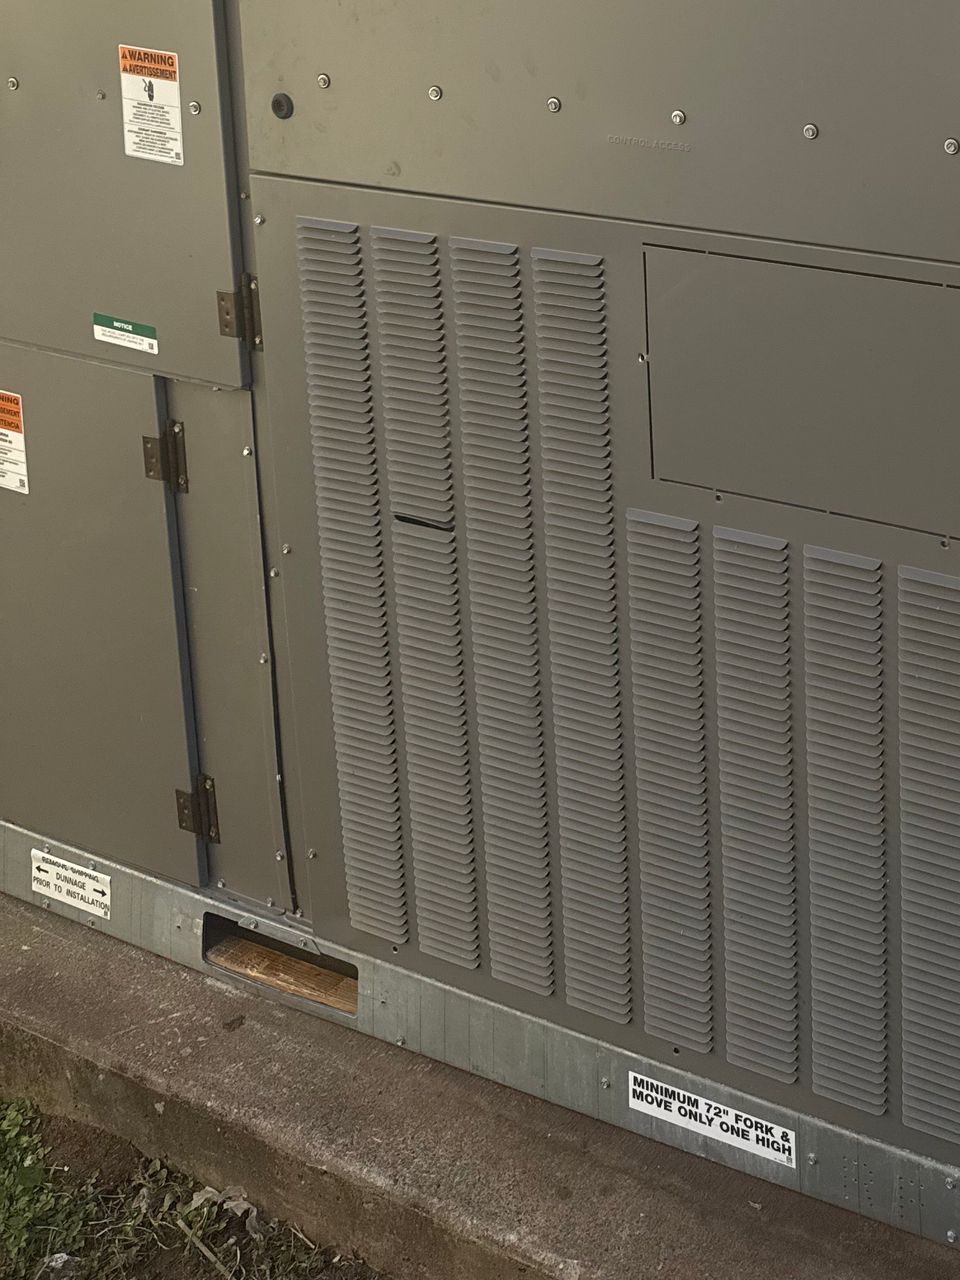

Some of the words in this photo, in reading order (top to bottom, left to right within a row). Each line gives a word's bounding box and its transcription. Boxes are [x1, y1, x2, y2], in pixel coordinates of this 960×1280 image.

[128, 50, 174, 66] WARNING
[129, 64, 176, 80] AVERTISSEMENT
[608, 134, 651, 149] CONTROL
[652, 139, 692, 153] ACCESS
[113, 321, 133, 331] NOTICE
[56, 872, 87, 891] DUNNAGE
[33, 876, 51, 889] PRIOR
[54, 883, 63, 894] TO
[66, 888, 110, 912] INSTALLATION
[633, 1075, 699, 1109] MINIMUM
[704, 1102, 729, 1118] 72"
[735, 1113, 775, 1138] FORK
[780, 1131, 791, 1144] &
[632, 1088, 673, 1113] MOVE
[677, 1106, 715, 1128] ONLY
[719, 1121, 751, 1142] ONE
[756, 1135, 792, 1157] HIGH
